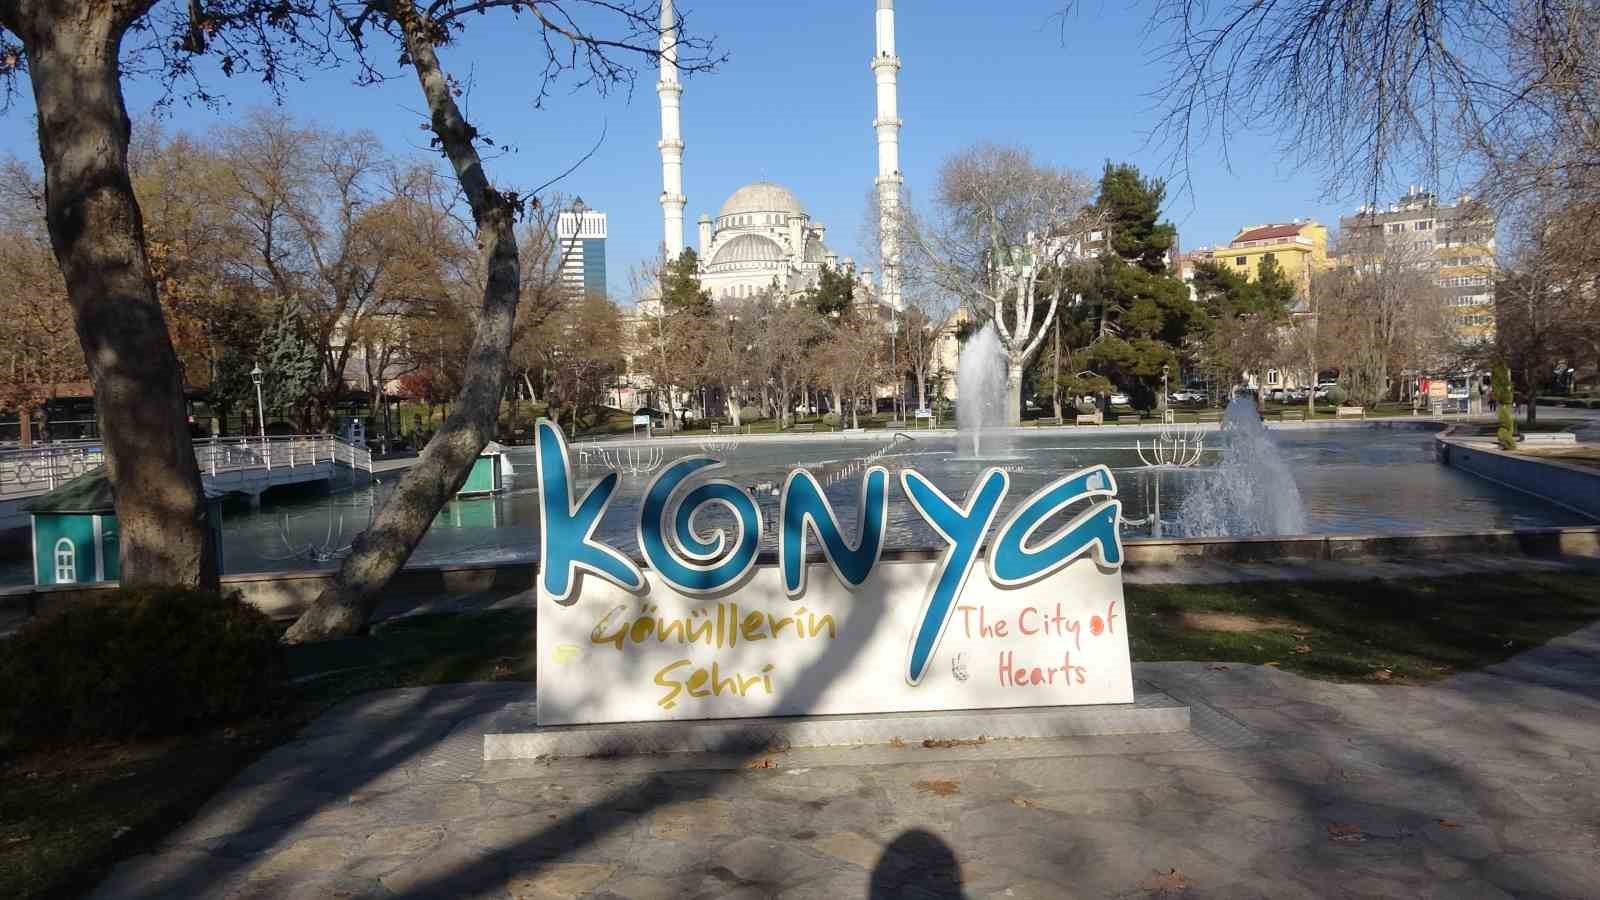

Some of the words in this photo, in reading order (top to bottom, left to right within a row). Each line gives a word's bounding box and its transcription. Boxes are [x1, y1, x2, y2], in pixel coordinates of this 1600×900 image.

[591, 603, 836, 650] Gönüllerin
[958, 605, 1009, 639] The
[1018, 603, 1081, 650] City
[1089, 601, 1119, 636] of
[654, 659, 775, 709] Şehri
[999, 651, 1087, 687] Hearts
